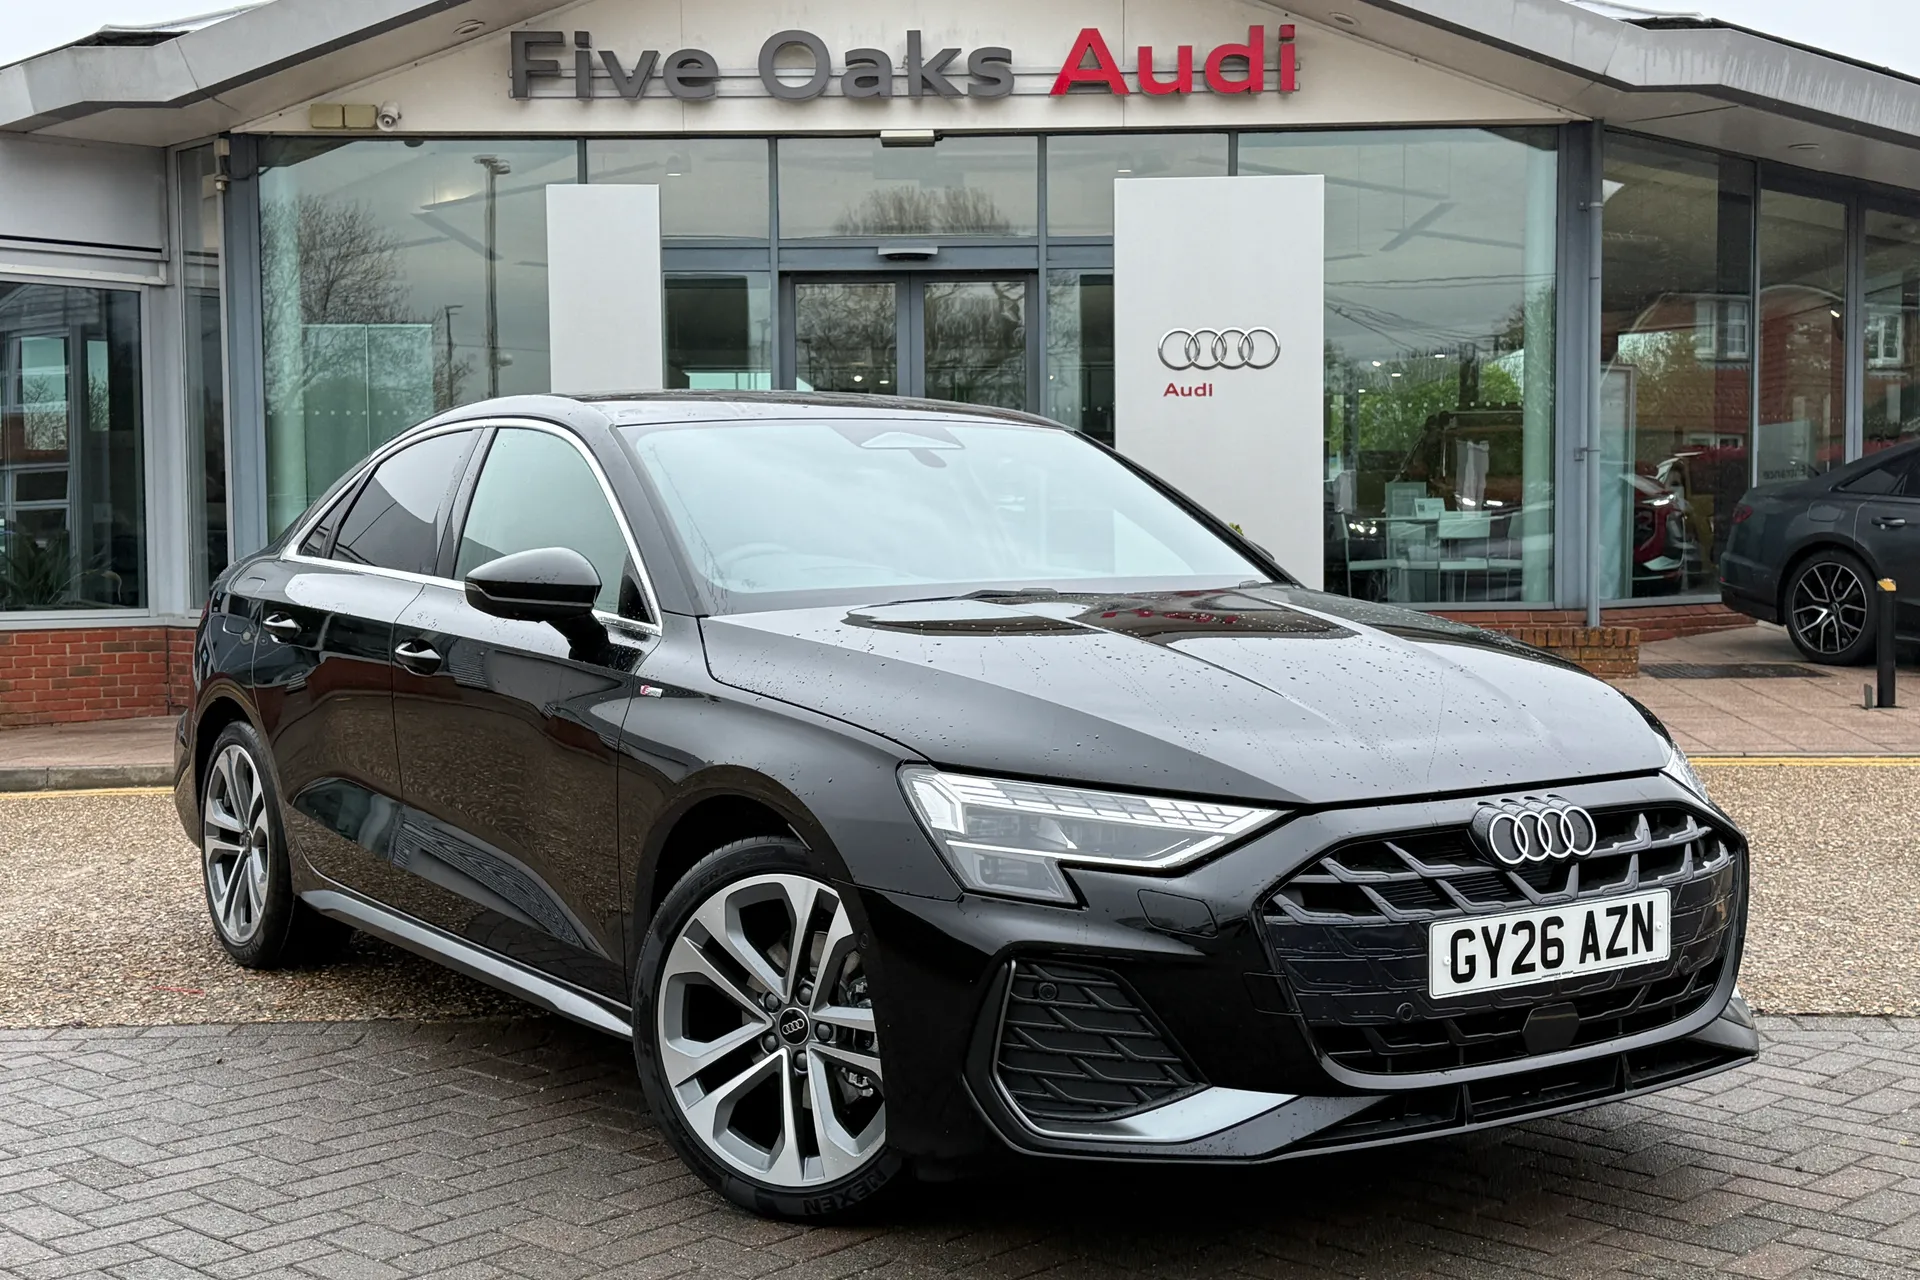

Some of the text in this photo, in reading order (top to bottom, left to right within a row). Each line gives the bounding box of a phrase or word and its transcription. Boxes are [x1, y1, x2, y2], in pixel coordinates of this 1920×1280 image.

[511, 24, 1296, 100] Five Oaks Audi
[1163, 382, 1213, 397] Audi
[1450, 900, 1654, 984] GY26 AZN
[803, 1168, 887, 1214] NEXEN
